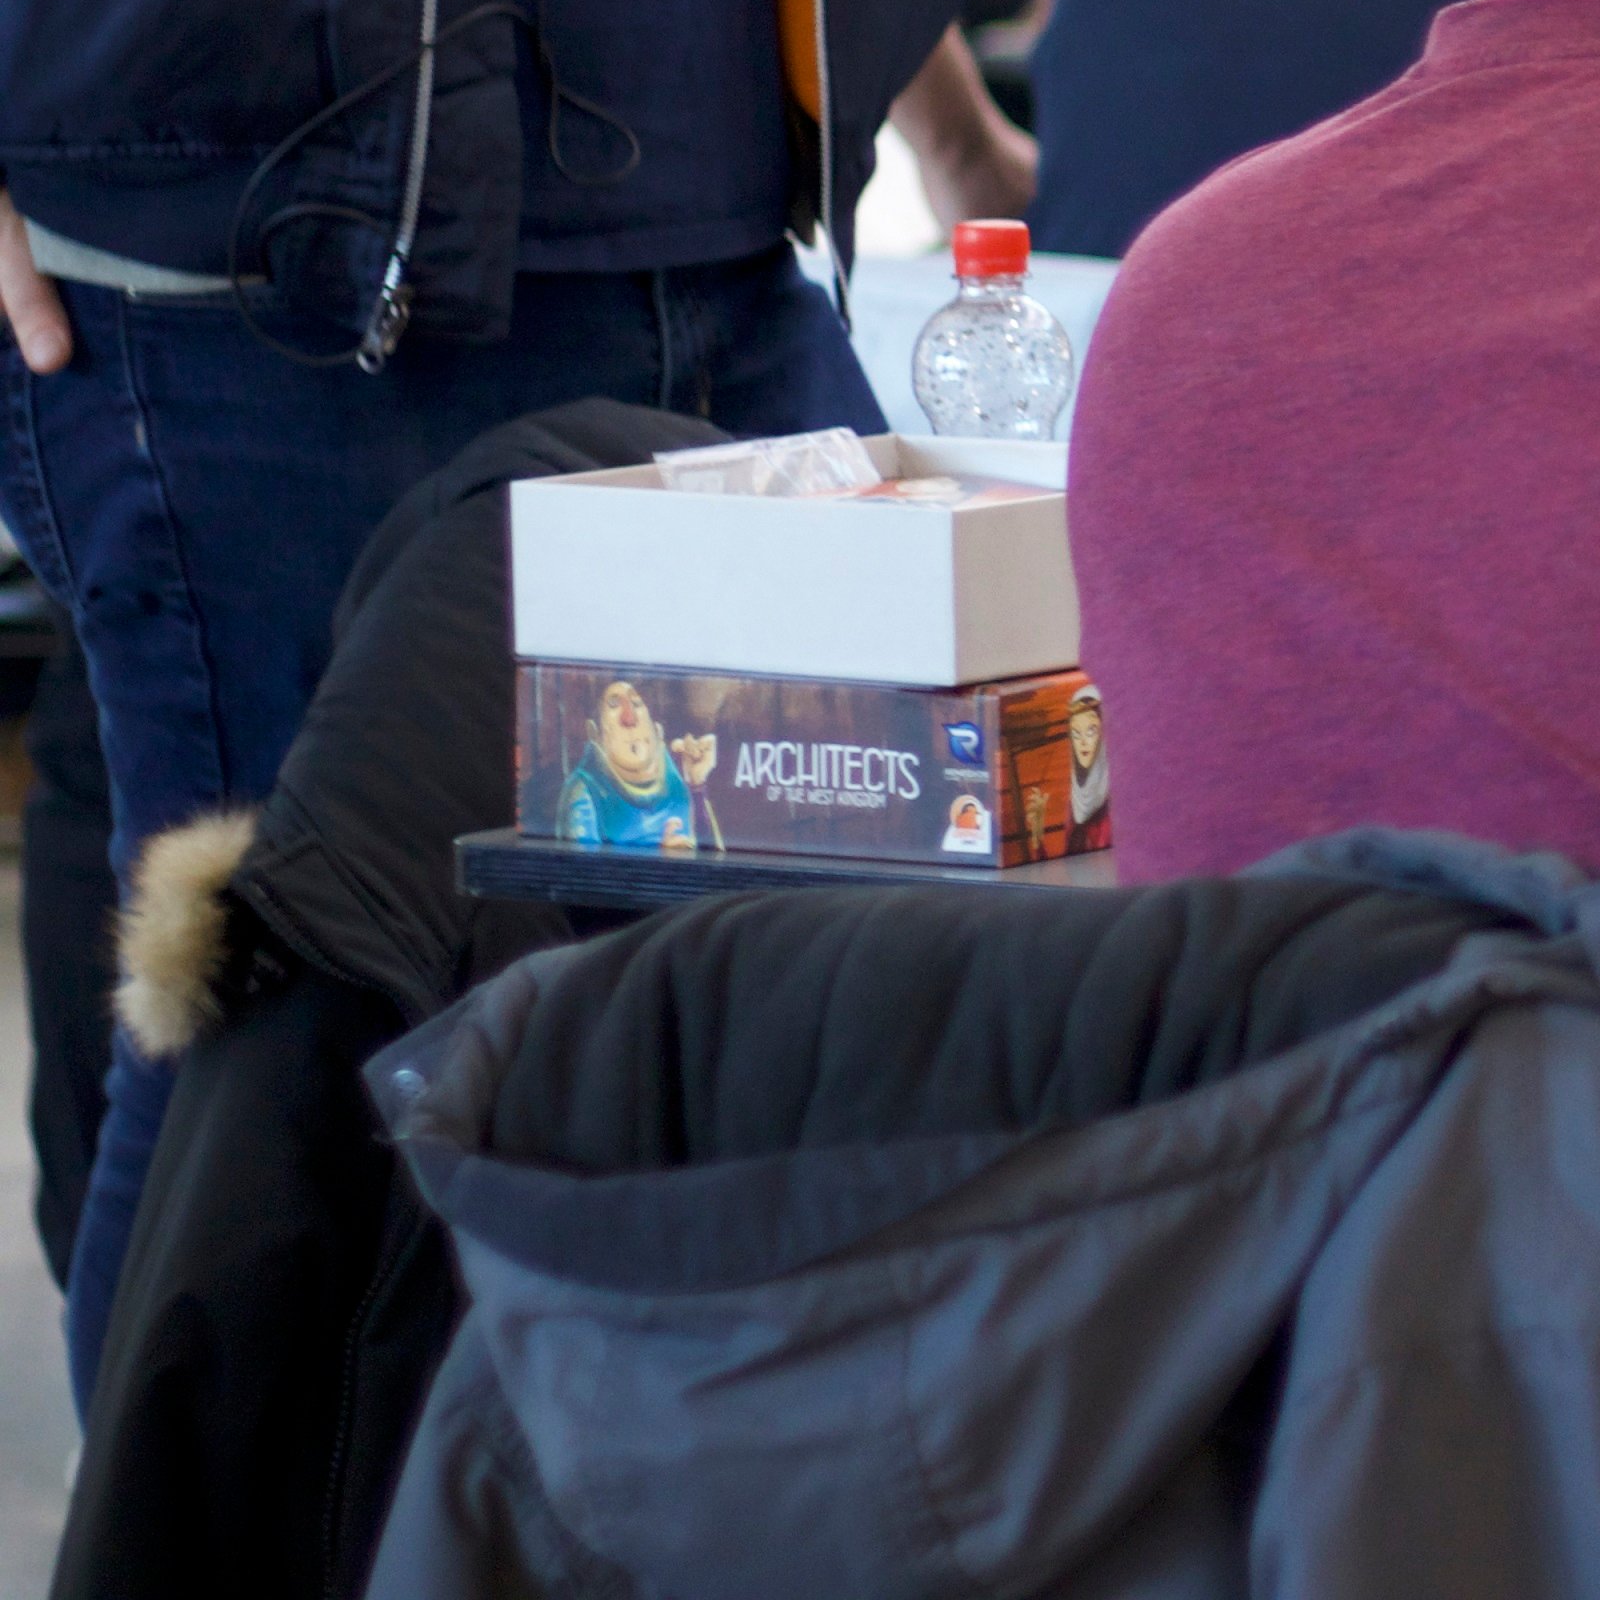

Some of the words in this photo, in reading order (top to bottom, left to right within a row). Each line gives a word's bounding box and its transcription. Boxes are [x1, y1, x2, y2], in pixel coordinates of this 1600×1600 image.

[734, 741, 920, 800] ARCHITECTS
[807, 788, 834, 806] WEST
[837, 790, 887, 809] KINGDOM
